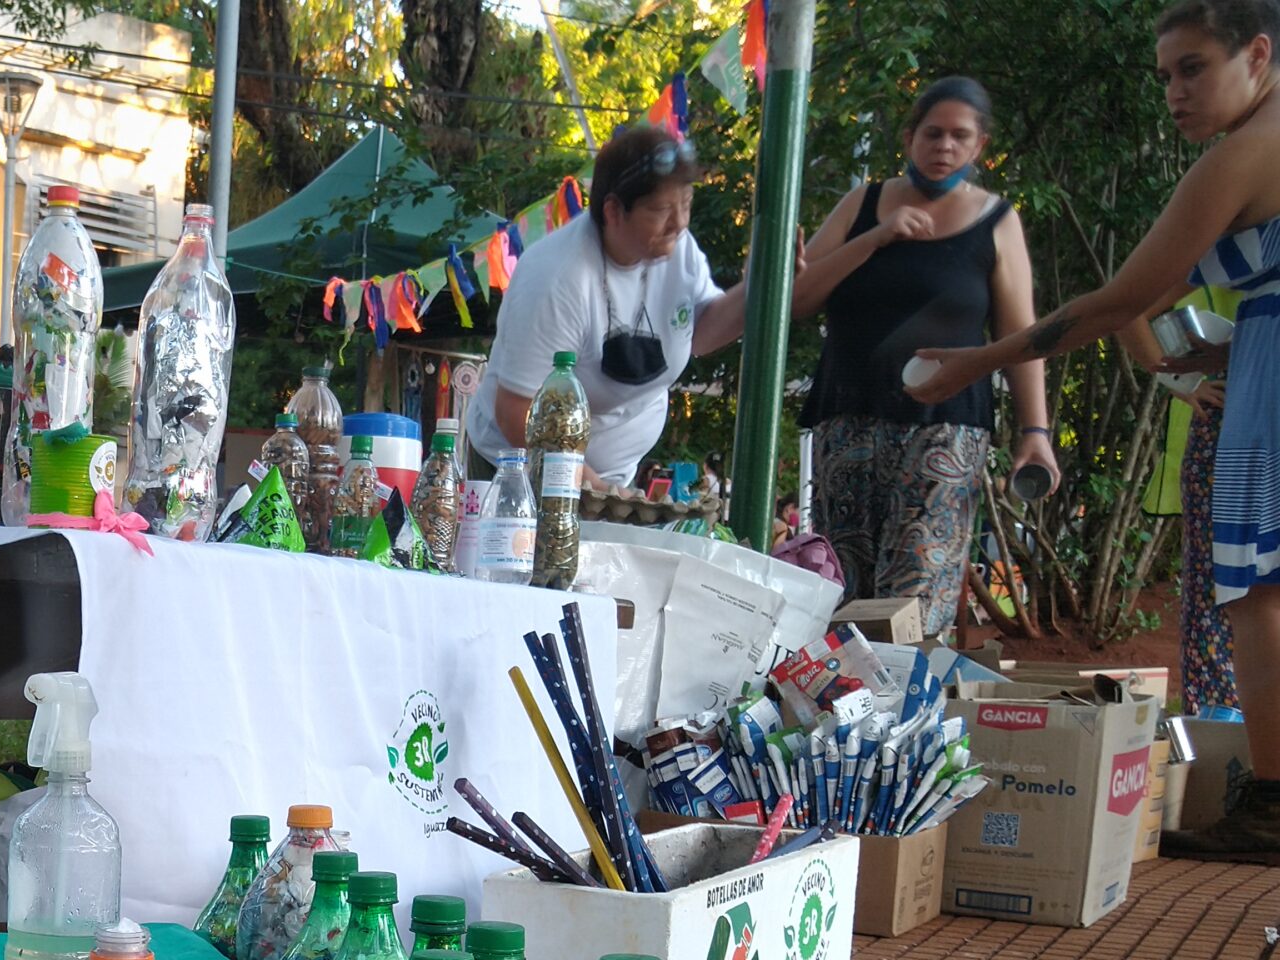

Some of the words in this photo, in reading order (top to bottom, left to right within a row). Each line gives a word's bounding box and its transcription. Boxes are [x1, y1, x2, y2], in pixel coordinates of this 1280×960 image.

[981, 709, 1043, 724] GANCIA
[1022, 763, 1047, 774] con
[1002, 775, 1077, 796] Pomelo
[423, 821, 448, 839] Iguaz
[707, 881, 739, 909] BOTELLAS
[738, 877, 748, 895] DE
[746, 872, 765, 892] AMOR
[802, 908, 819, 945] 3R
